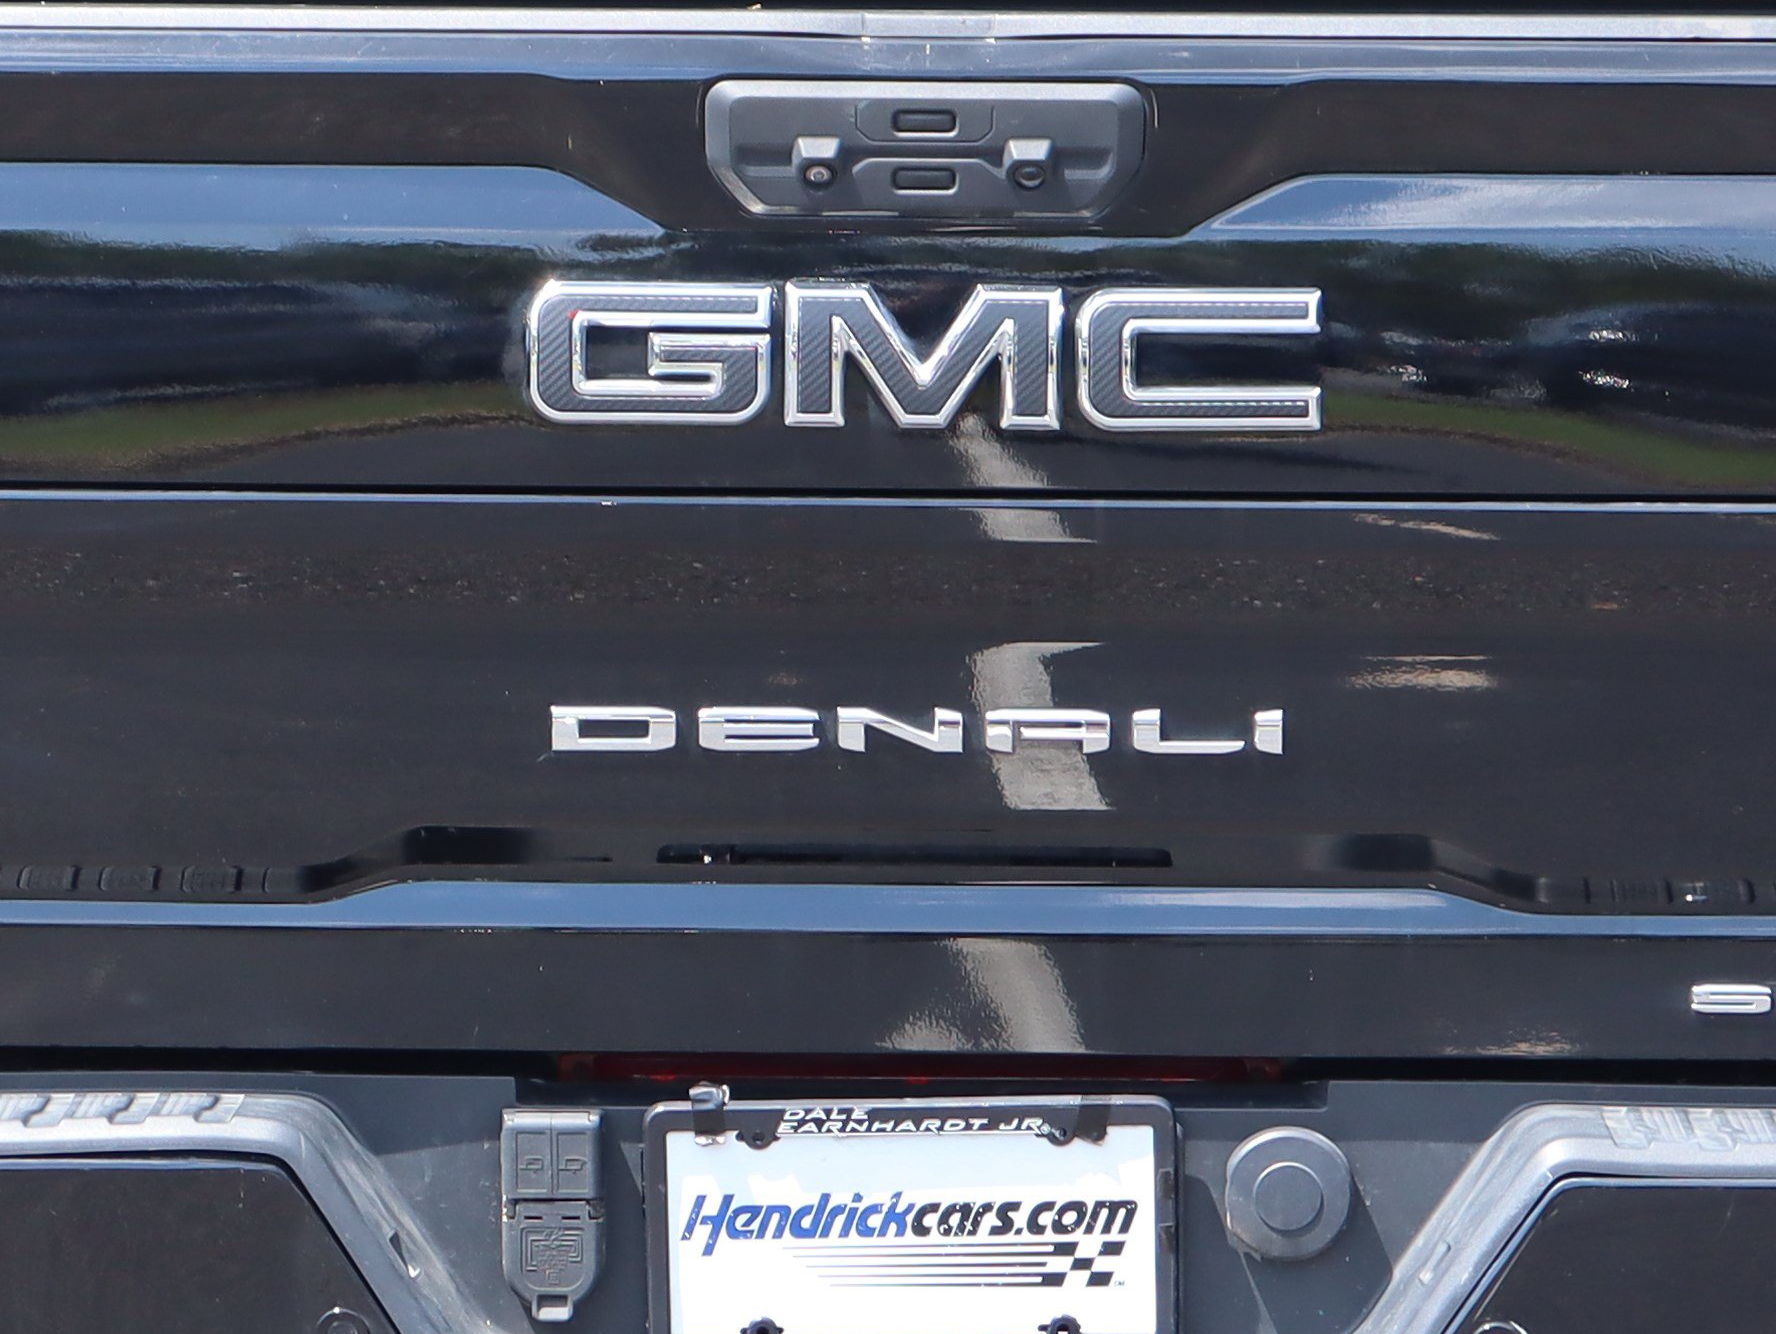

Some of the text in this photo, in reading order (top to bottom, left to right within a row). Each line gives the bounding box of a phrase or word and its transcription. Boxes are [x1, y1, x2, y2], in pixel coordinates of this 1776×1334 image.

[527, 279, 1323, 431] GMC
[550, 705, 1284, 755] DENALI
[777, 1117, 1044, 1135] EARNHARDT JR
[783, 1106, 871, 1121] DALE
[680, 1191, 1139, 1257] Hendrickcars.com
